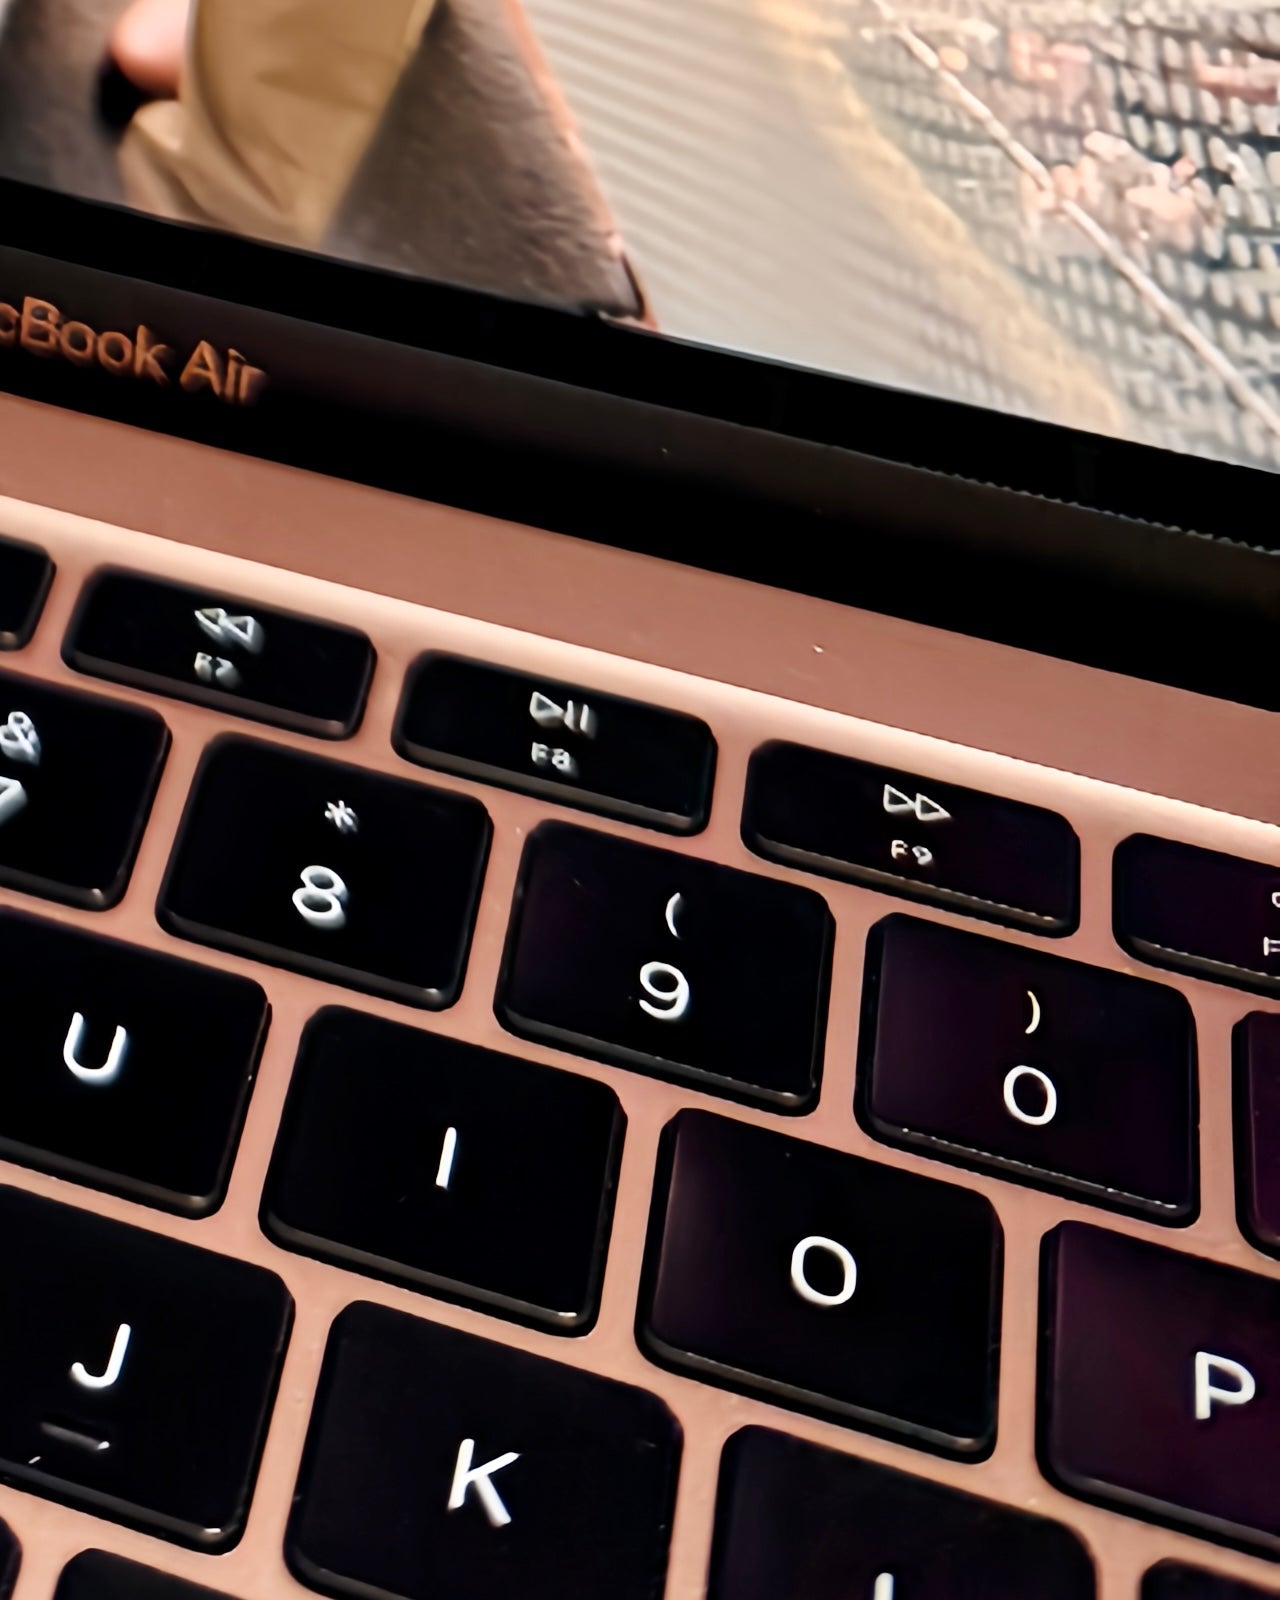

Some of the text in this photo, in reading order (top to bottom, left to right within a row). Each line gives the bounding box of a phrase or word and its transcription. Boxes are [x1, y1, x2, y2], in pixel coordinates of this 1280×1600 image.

[179, 340, 268, 405] Air
[890, 839, 933, 866] F9
[291, 864, 348, 928] 8
[638, 960, 690, 1021] 9
[62, 1011, 128, 1085] U
[435, 1126, 458, 1190] I
[790, 1235, 858, 1307] O
[70, 1323, 132, 1390] J
[1194, 1350, 1256, 1420] P
[447, 1438, 521, 1528] K
